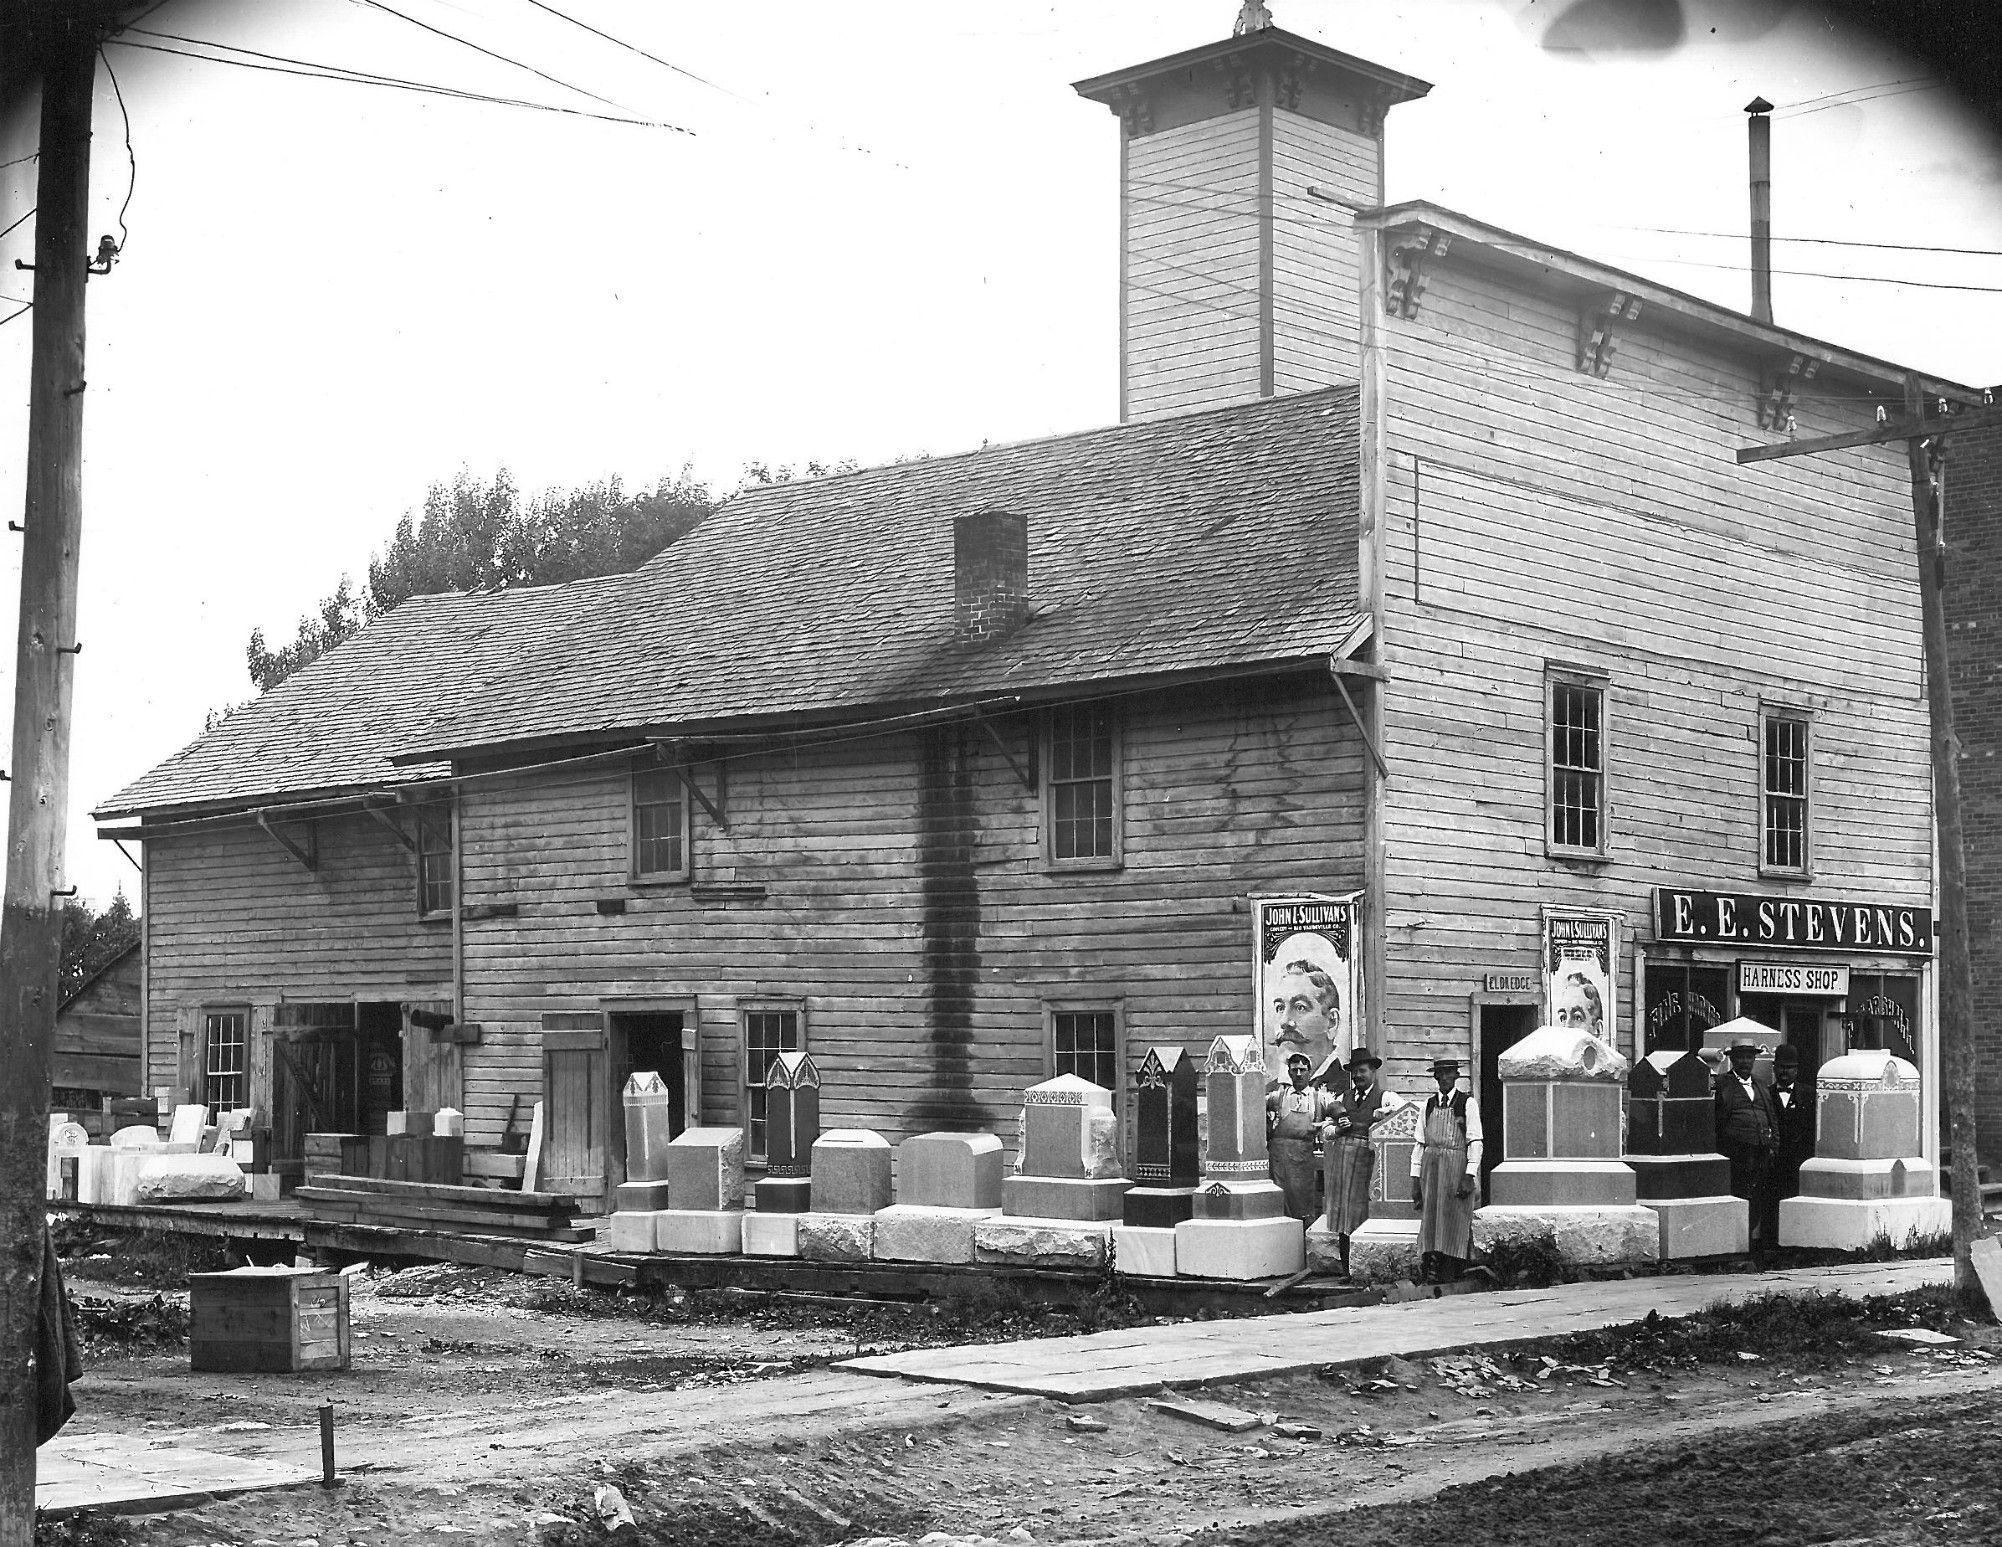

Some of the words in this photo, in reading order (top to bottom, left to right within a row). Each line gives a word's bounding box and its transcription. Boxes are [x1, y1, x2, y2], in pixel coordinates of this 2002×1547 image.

[1265, 907, 1291, 926] JOHN
[1672, 894, 1707, 935] E.
[1716, 897, 1749, 937] E.
[1758, 901, 1925, 948] STEVENS.
[1551, 920, 1570, 938] JOHN
[1489, 976, 1531, 990] ELDREDGE
[1742, 967, 1801, 989] HARNESS
